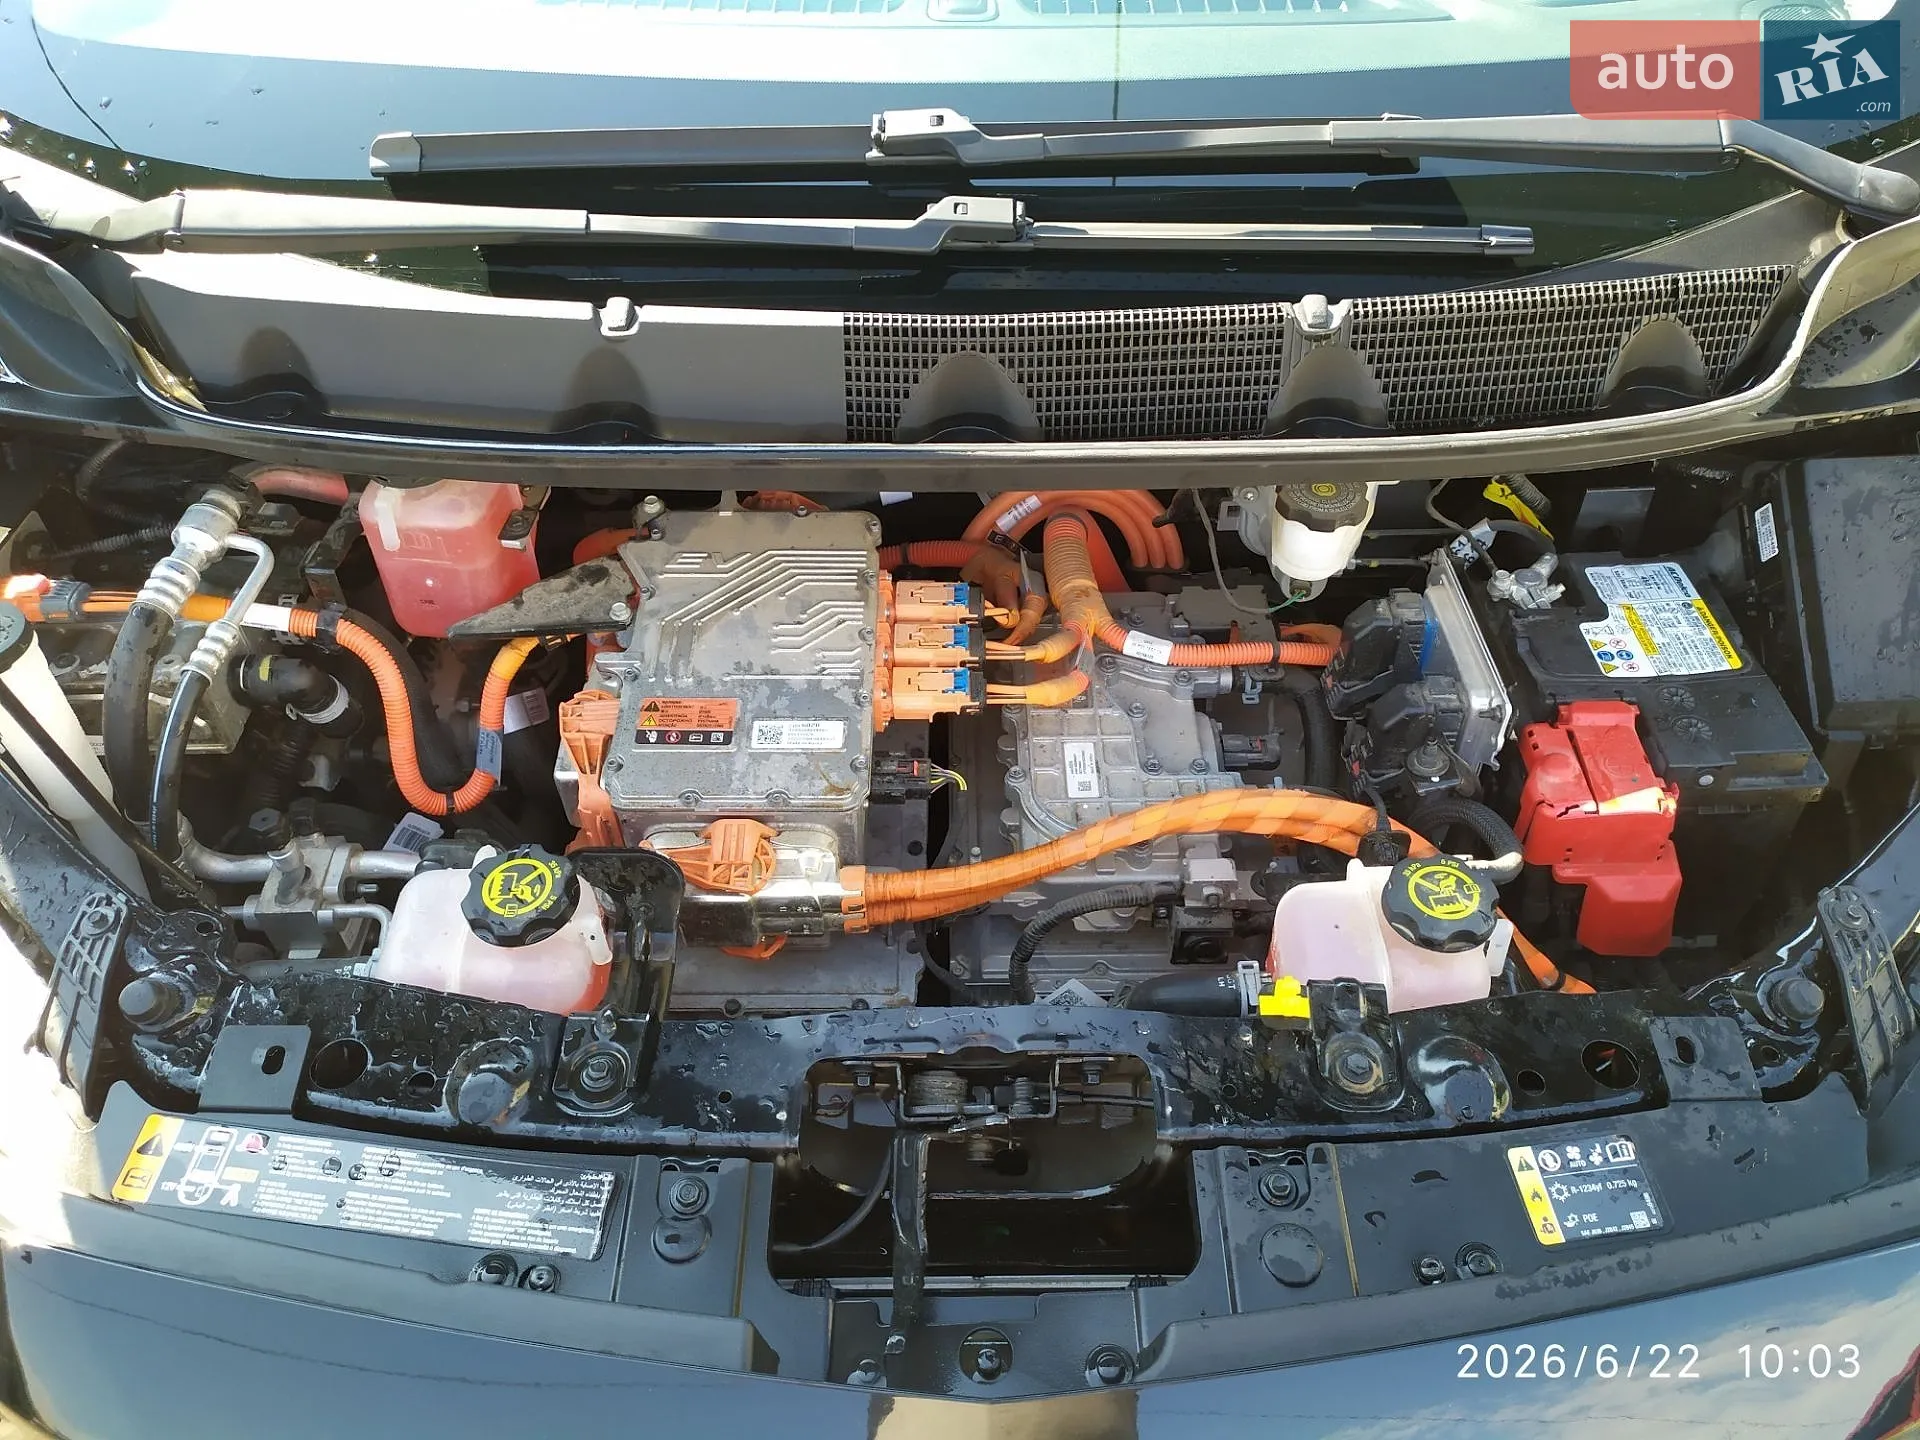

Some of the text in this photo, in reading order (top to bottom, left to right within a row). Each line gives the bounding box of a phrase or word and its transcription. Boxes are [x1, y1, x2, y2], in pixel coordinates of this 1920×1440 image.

[1569, 1160, 1586, 1168] AUTO
[1571, 1181, 1603, 1195] R-1234yf
[1606, 1181, 1627, 1191] 0.725
[1582, 1213, 1599, 1224] POE
